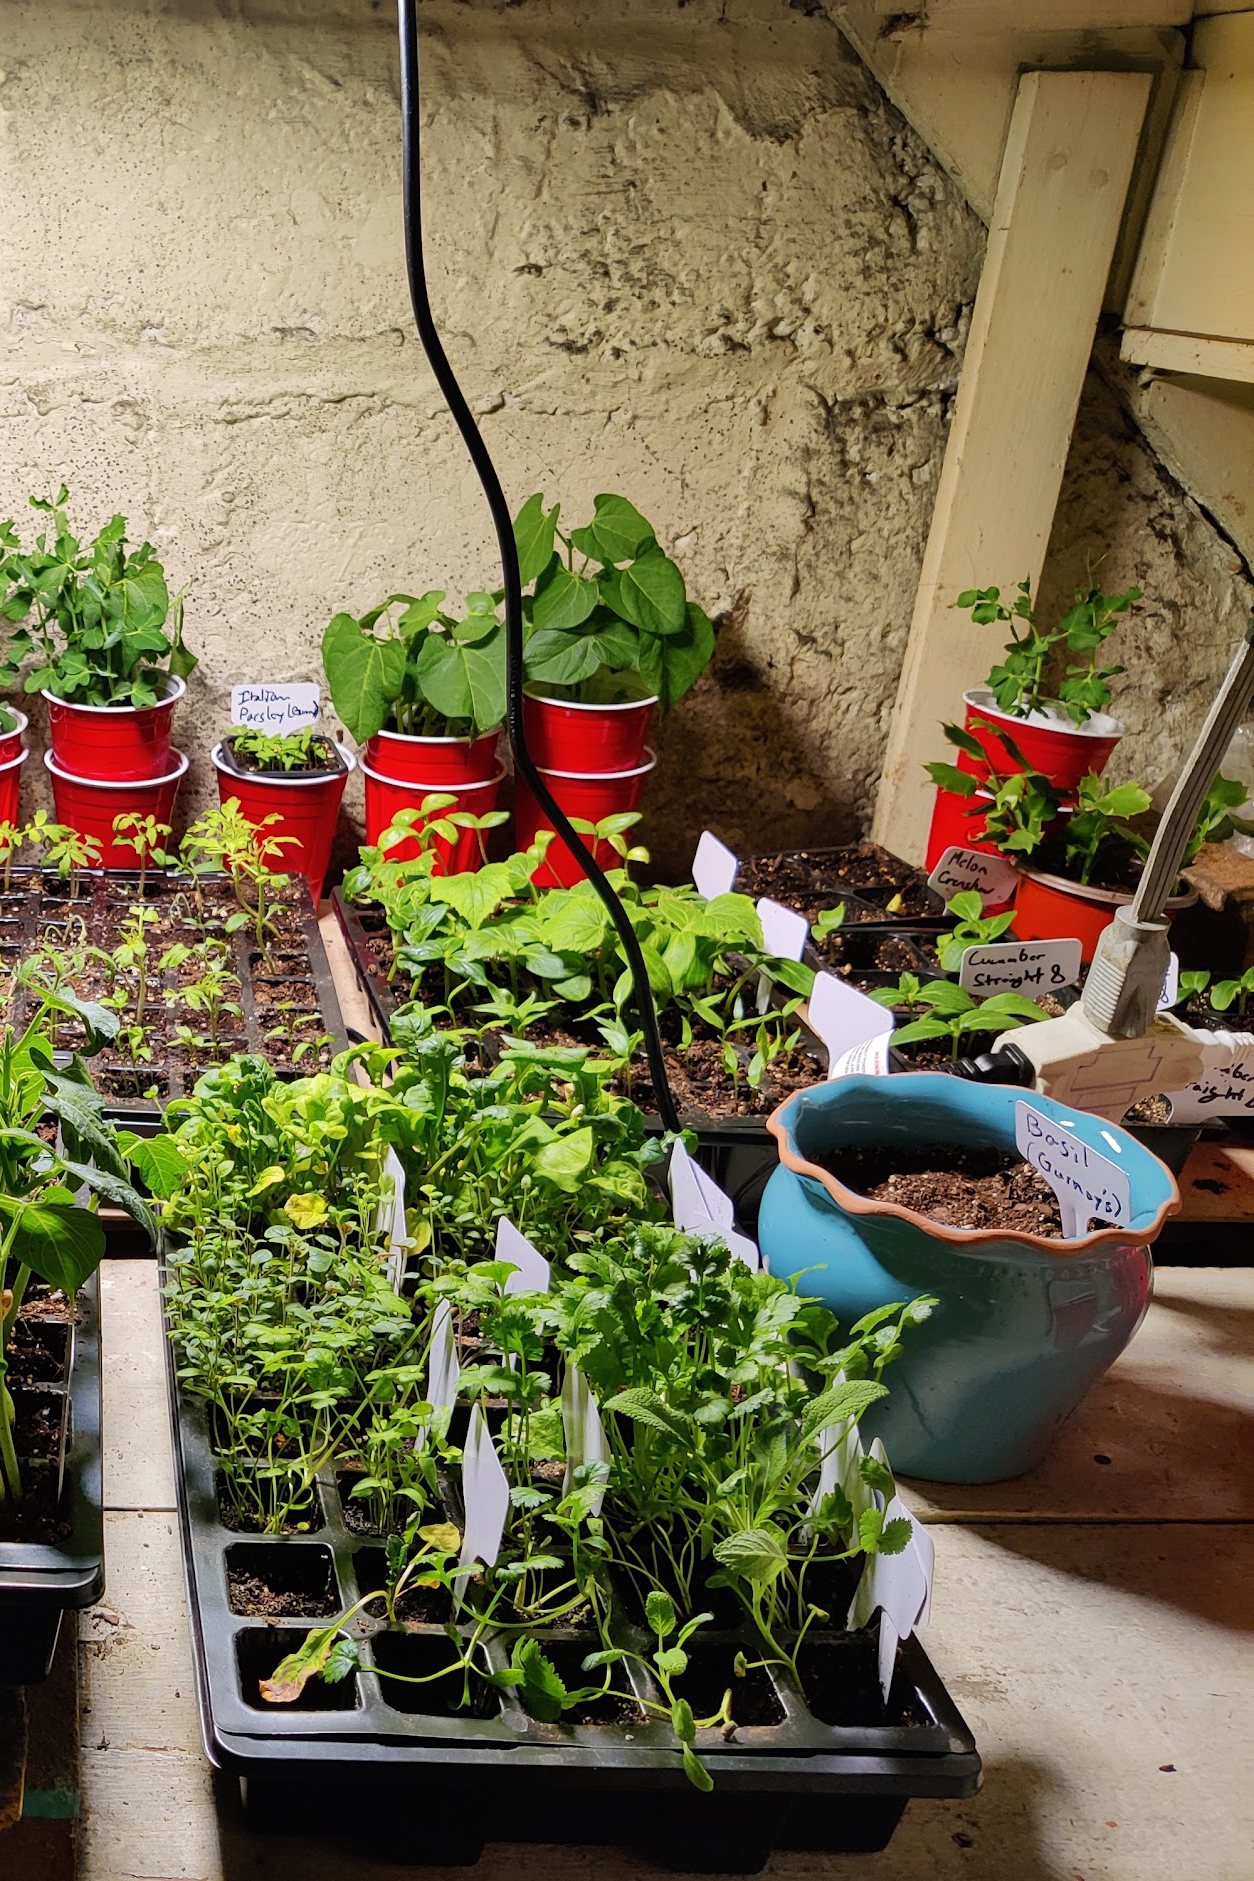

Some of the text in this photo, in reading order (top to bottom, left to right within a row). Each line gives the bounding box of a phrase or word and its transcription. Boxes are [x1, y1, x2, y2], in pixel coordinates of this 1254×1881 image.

[238, 688, 290, 705] Italian
[239, 706, 285, 724] Parsley
[947, 851, 987, 875] Melon
[1050, 964, 1066, 984] 8
[1026, 1113, 1089, 1168] Basil
